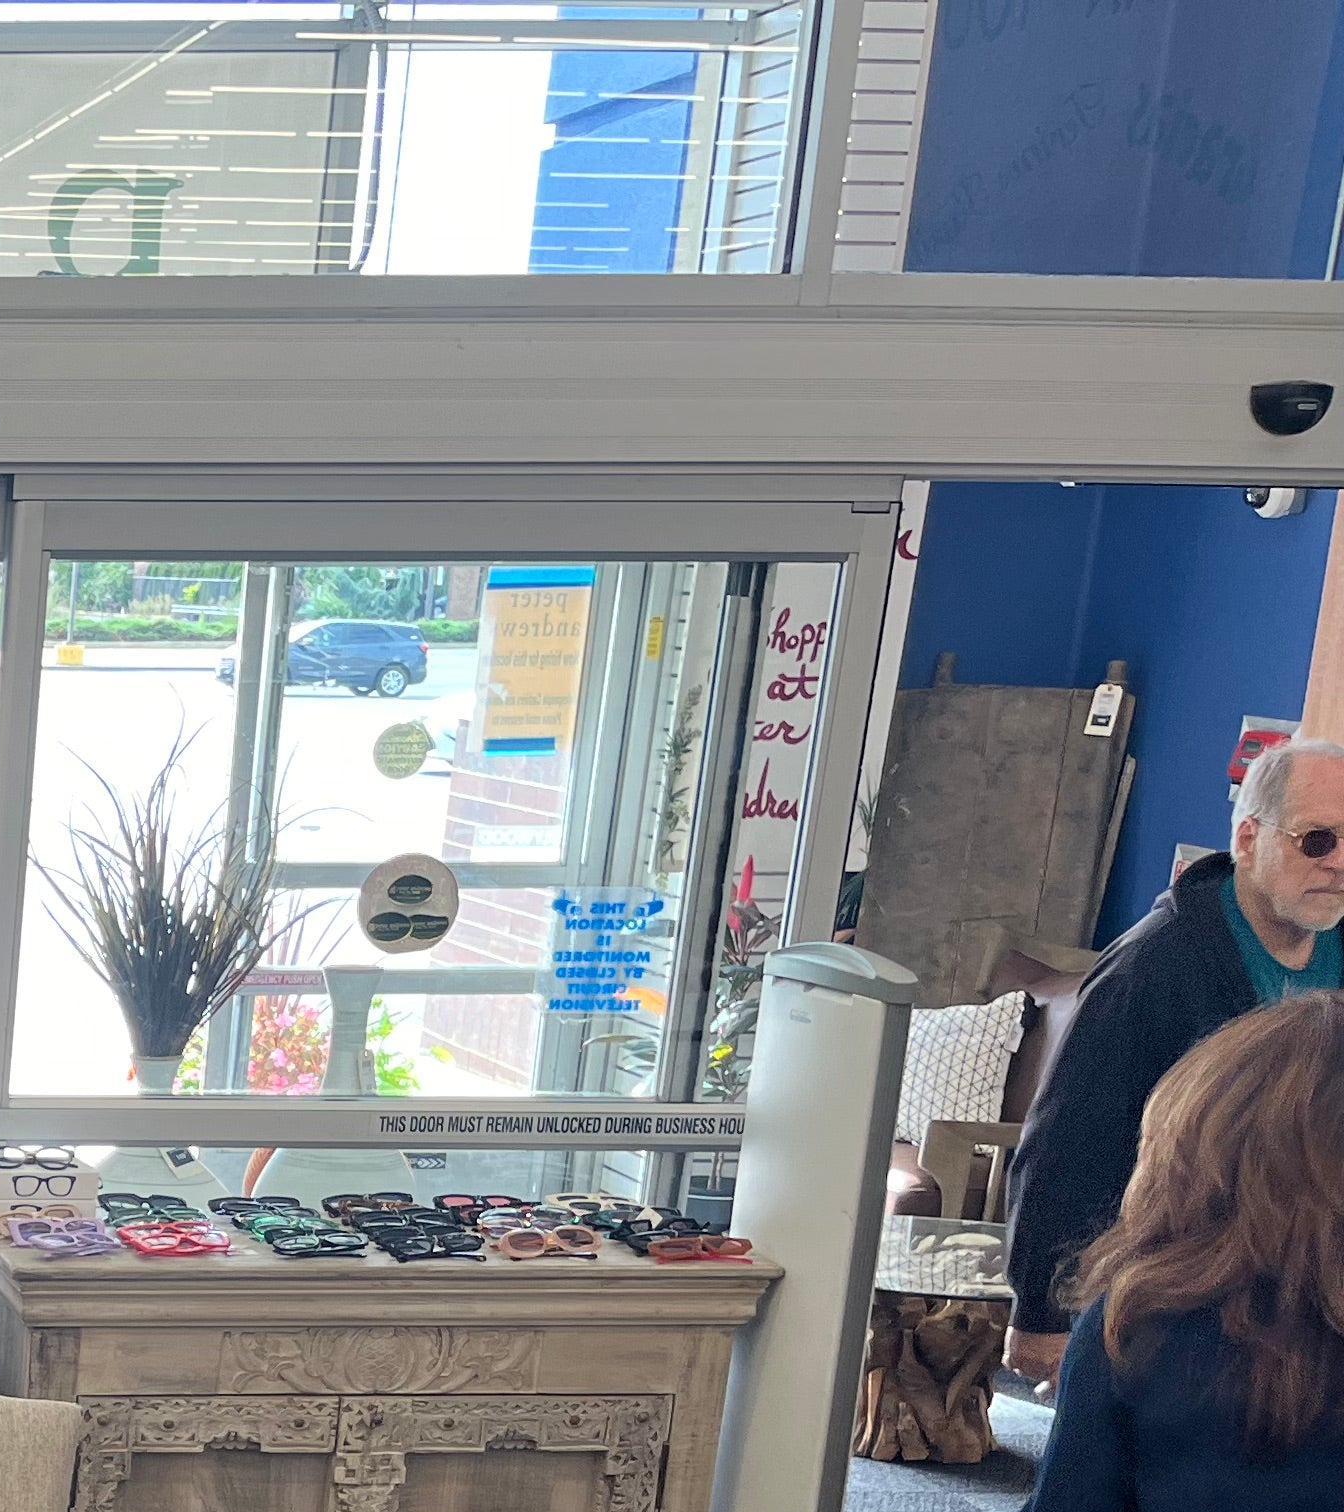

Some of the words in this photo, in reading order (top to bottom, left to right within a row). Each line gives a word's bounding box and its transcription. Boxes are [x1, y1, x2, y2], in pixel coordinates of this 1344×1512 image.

[767, 663, 820, 701] at
[379, 1115, 406, 1133] THIS
[410, 1115, 444, 1133] DOOR
[448, 1115, 483, 1133] MUST
[486, 1116, 533, 1133] REMAIN
[537, 1116, 601, 1134] UNLOCKED
[604, 1117, 652, 1135] DURING
[656, 1117, 716, 1135] BUSINESS
